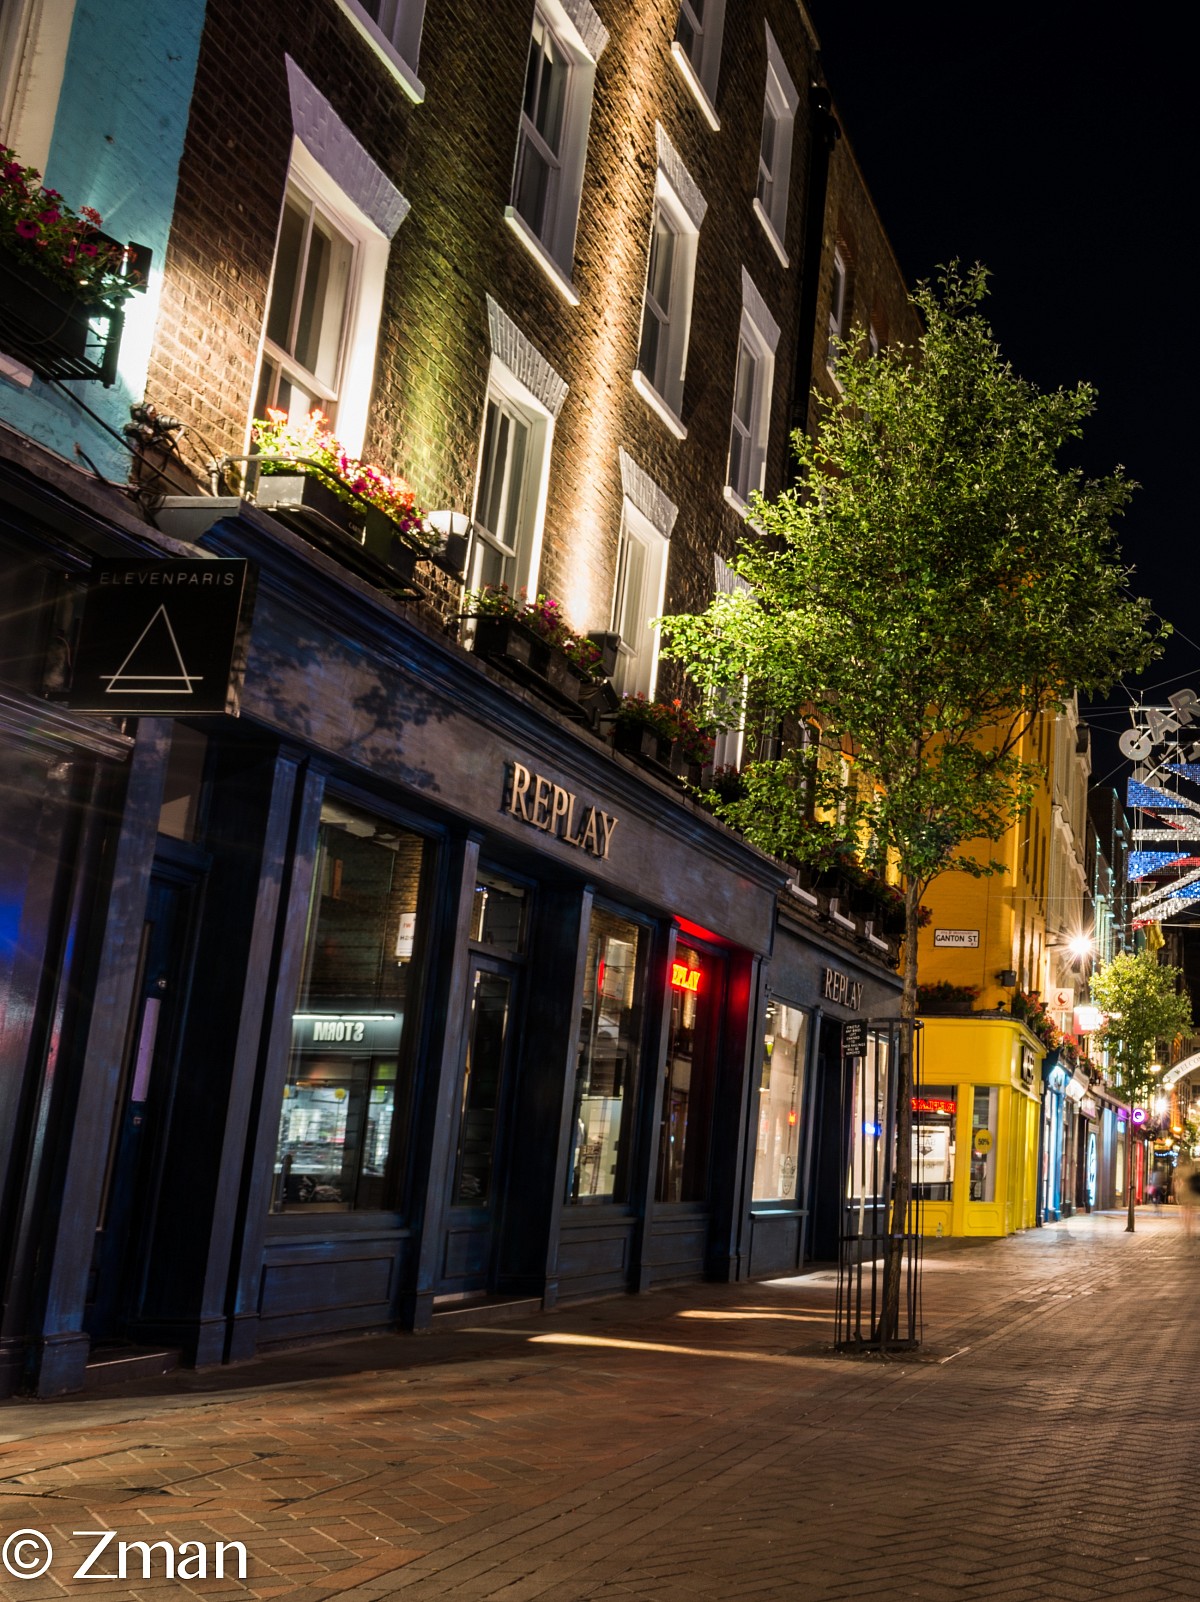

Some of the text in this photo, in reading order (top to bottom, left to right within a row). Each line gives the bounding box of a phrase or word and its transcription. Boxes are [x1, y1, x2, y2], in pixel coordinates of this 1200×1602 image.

[100, 572, 235, 586] ELEVENPARIS
[508, 761, 620, 861] REPLAY
[935, 934, 978, 943] GANTON ST
[825, 967, 864, 1012] REPLAY
[978, 1138, 990, 1146] 50%
